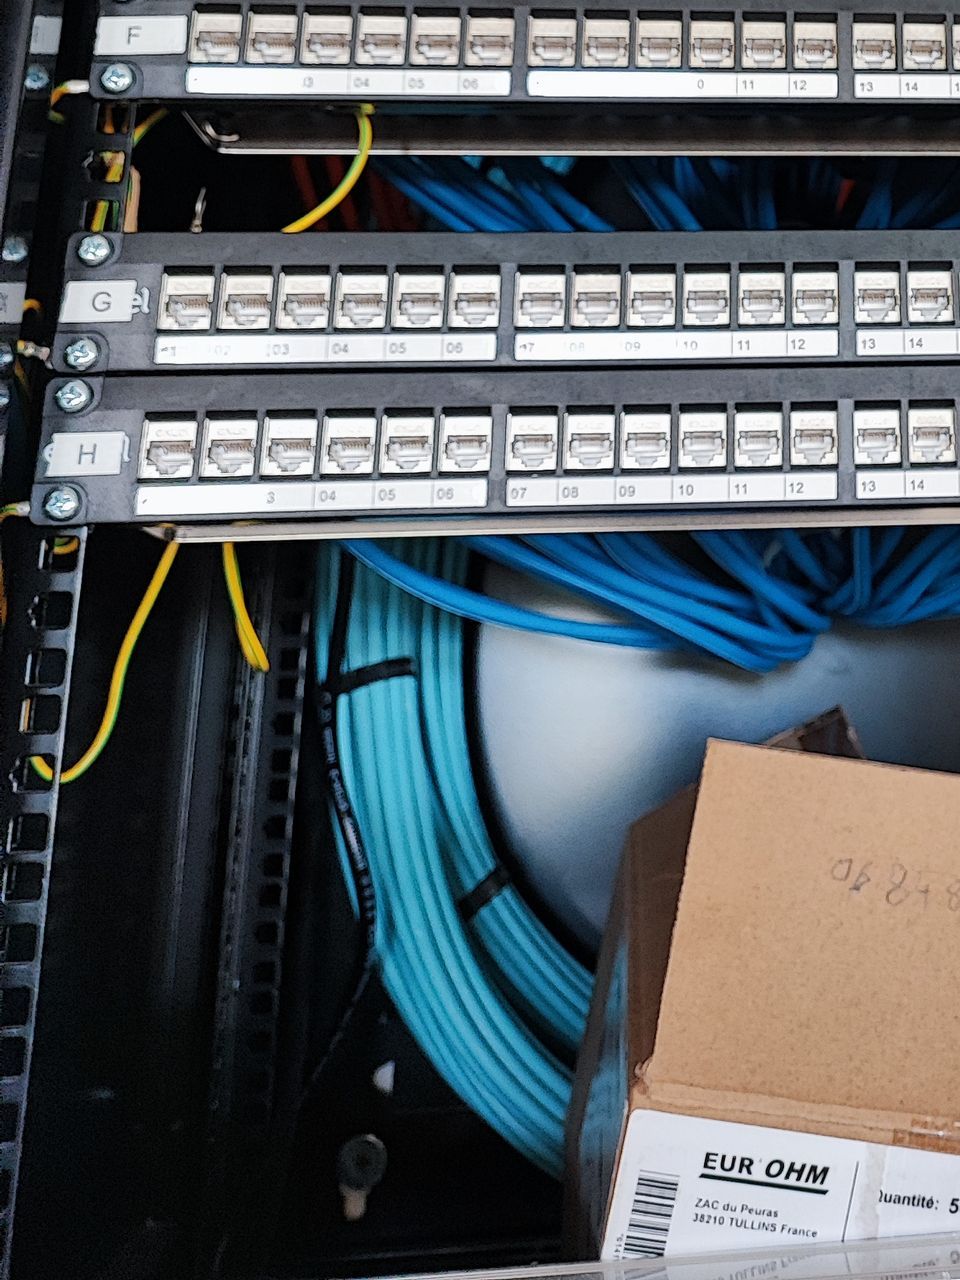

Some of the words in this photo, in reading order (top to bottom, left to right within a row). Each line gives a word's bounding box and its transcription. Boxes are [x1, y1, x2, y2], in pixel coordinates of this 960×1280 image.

[127, 25, 143, 45] F
[353, 76, 370, 89] 04
[407, 77, 425, 89] 05
[462, 78, 479, 90] 06
[741, 79, 755, 90] 11
[792, 80, 808, 91] 12
[859, 81, 874, 92] 13
[905, 82, 919, 92] 14
[91, 291, 113, 312] G
[271, 343, 290, 356] 03
[331, 342, 350, 355] 04
[389, 342, 407, 354] 05
[445, 341, 464, 353] 06
[683, 340, 699, 351] 10
[736, 339, 750, 351] 11
[790, 338, 806, 351] 12
[861, 338, 876, 350] 13
[908, 337, 923, 349] 14
[78, 443, 97, 465] H
[510, 487, 528, 500] 07
[562, 486, 580, 499] 08
[618, 485, 636, 497] 09
[679, 484, 694, 496] 10
[734, 483, 748, 495] 11
[788, 482, 805, 494] 12
[861, 480, 876, 492] 13
[910, 479, 925, 491] 14
[319, 490, 336, 502] 04
[378, 489, 396, 501] 05
[436, 488, 454, 501] 06
[695, 1198, 719, 1210] ZAC
[722, 1203, 737, 1213] du
[740, 1204, 779, 1218] Peuras
[692, 1212, 725, 1226] 38210
[729, 1217, 777, 1233] TULLINS
[780, 1224, 818, 1239] France
